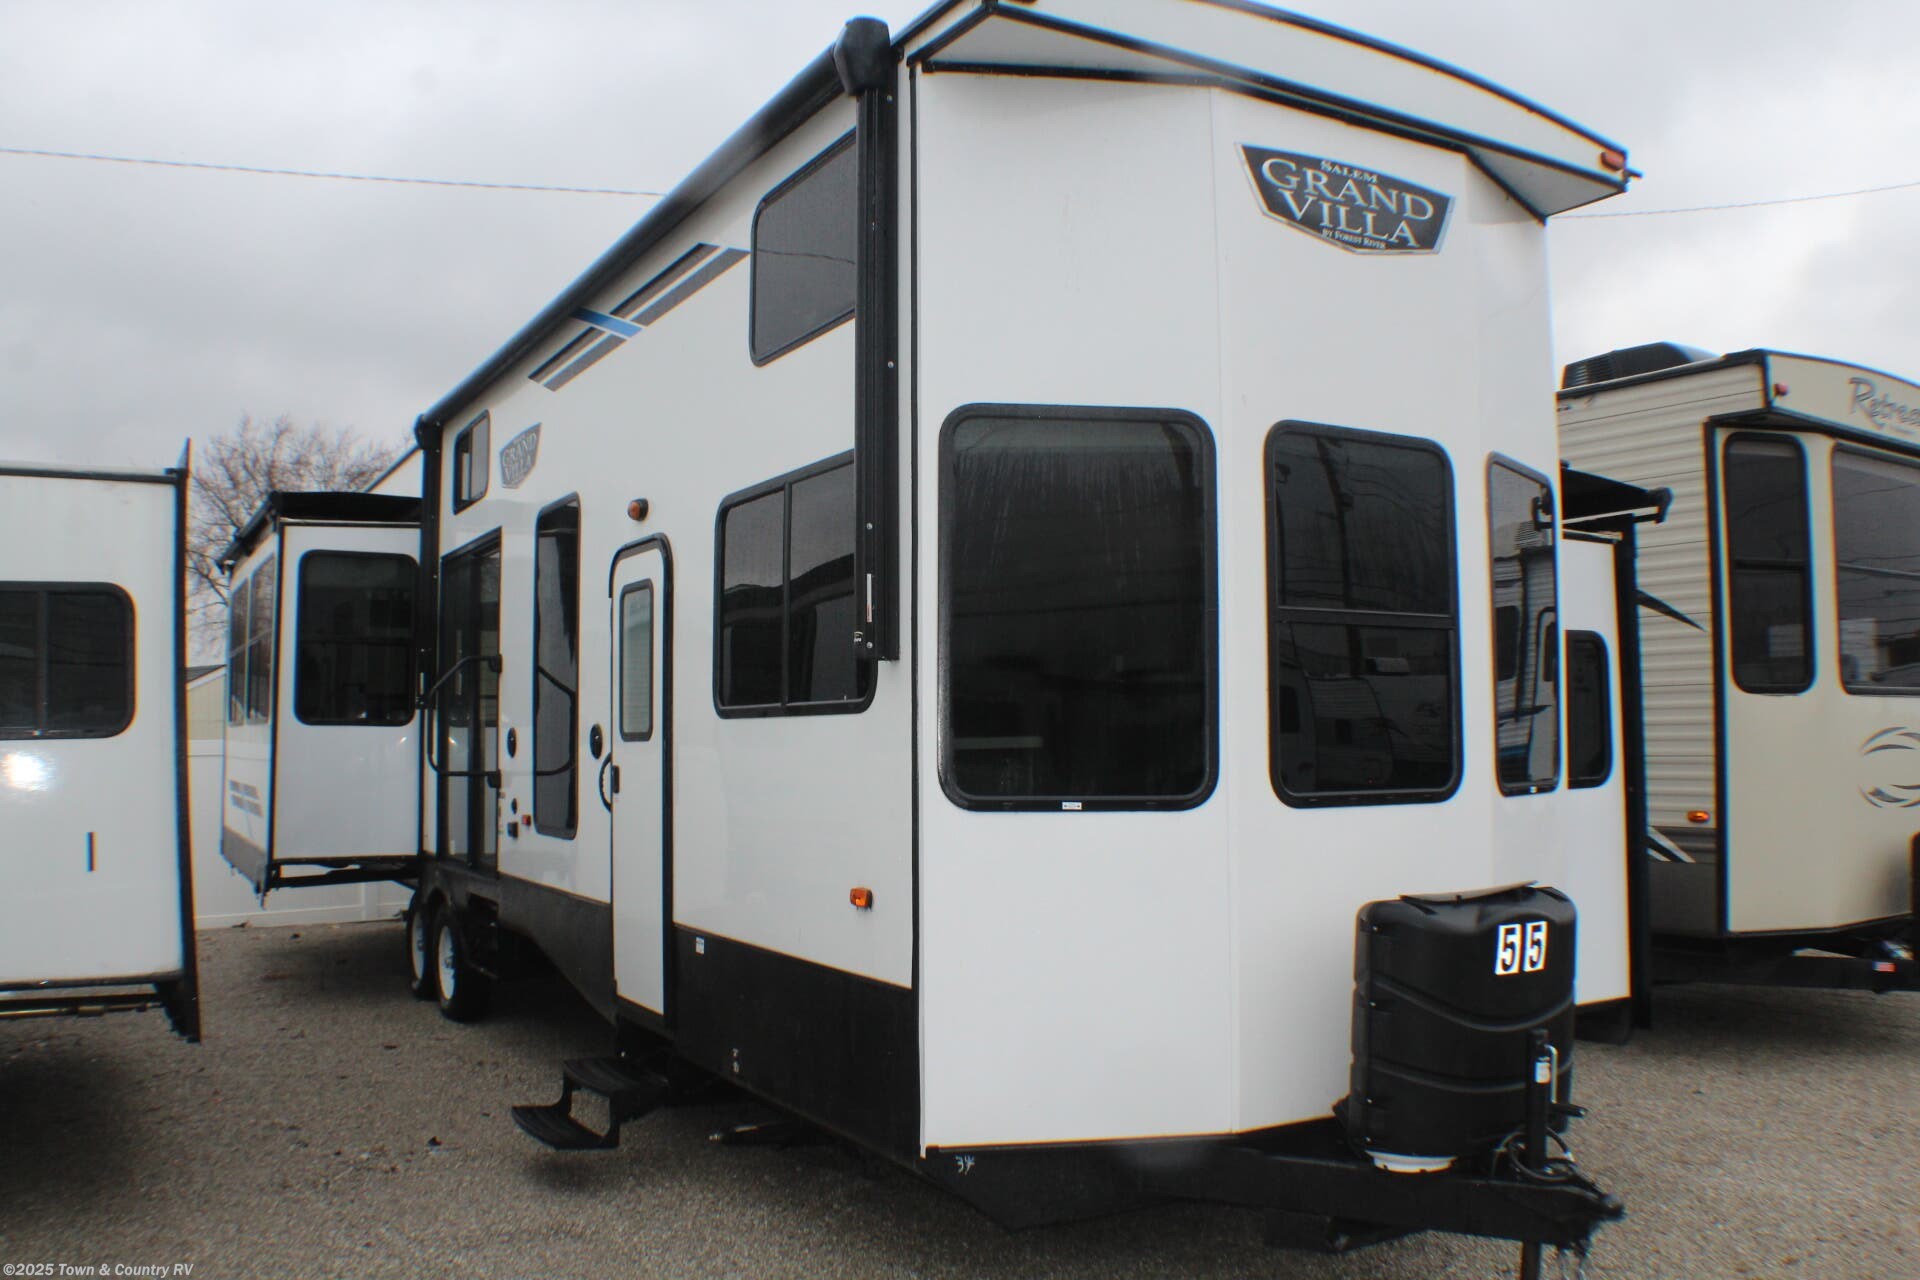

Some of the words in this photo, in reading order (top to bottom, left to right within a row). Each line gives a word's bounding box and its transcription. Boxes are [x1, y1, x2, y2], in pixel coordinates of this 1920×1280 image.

[1262, 159, 1434, 220] GRAND
[1277, 188, 1421, 248] VILLA
[1499, 923, 1544, 973] 55
